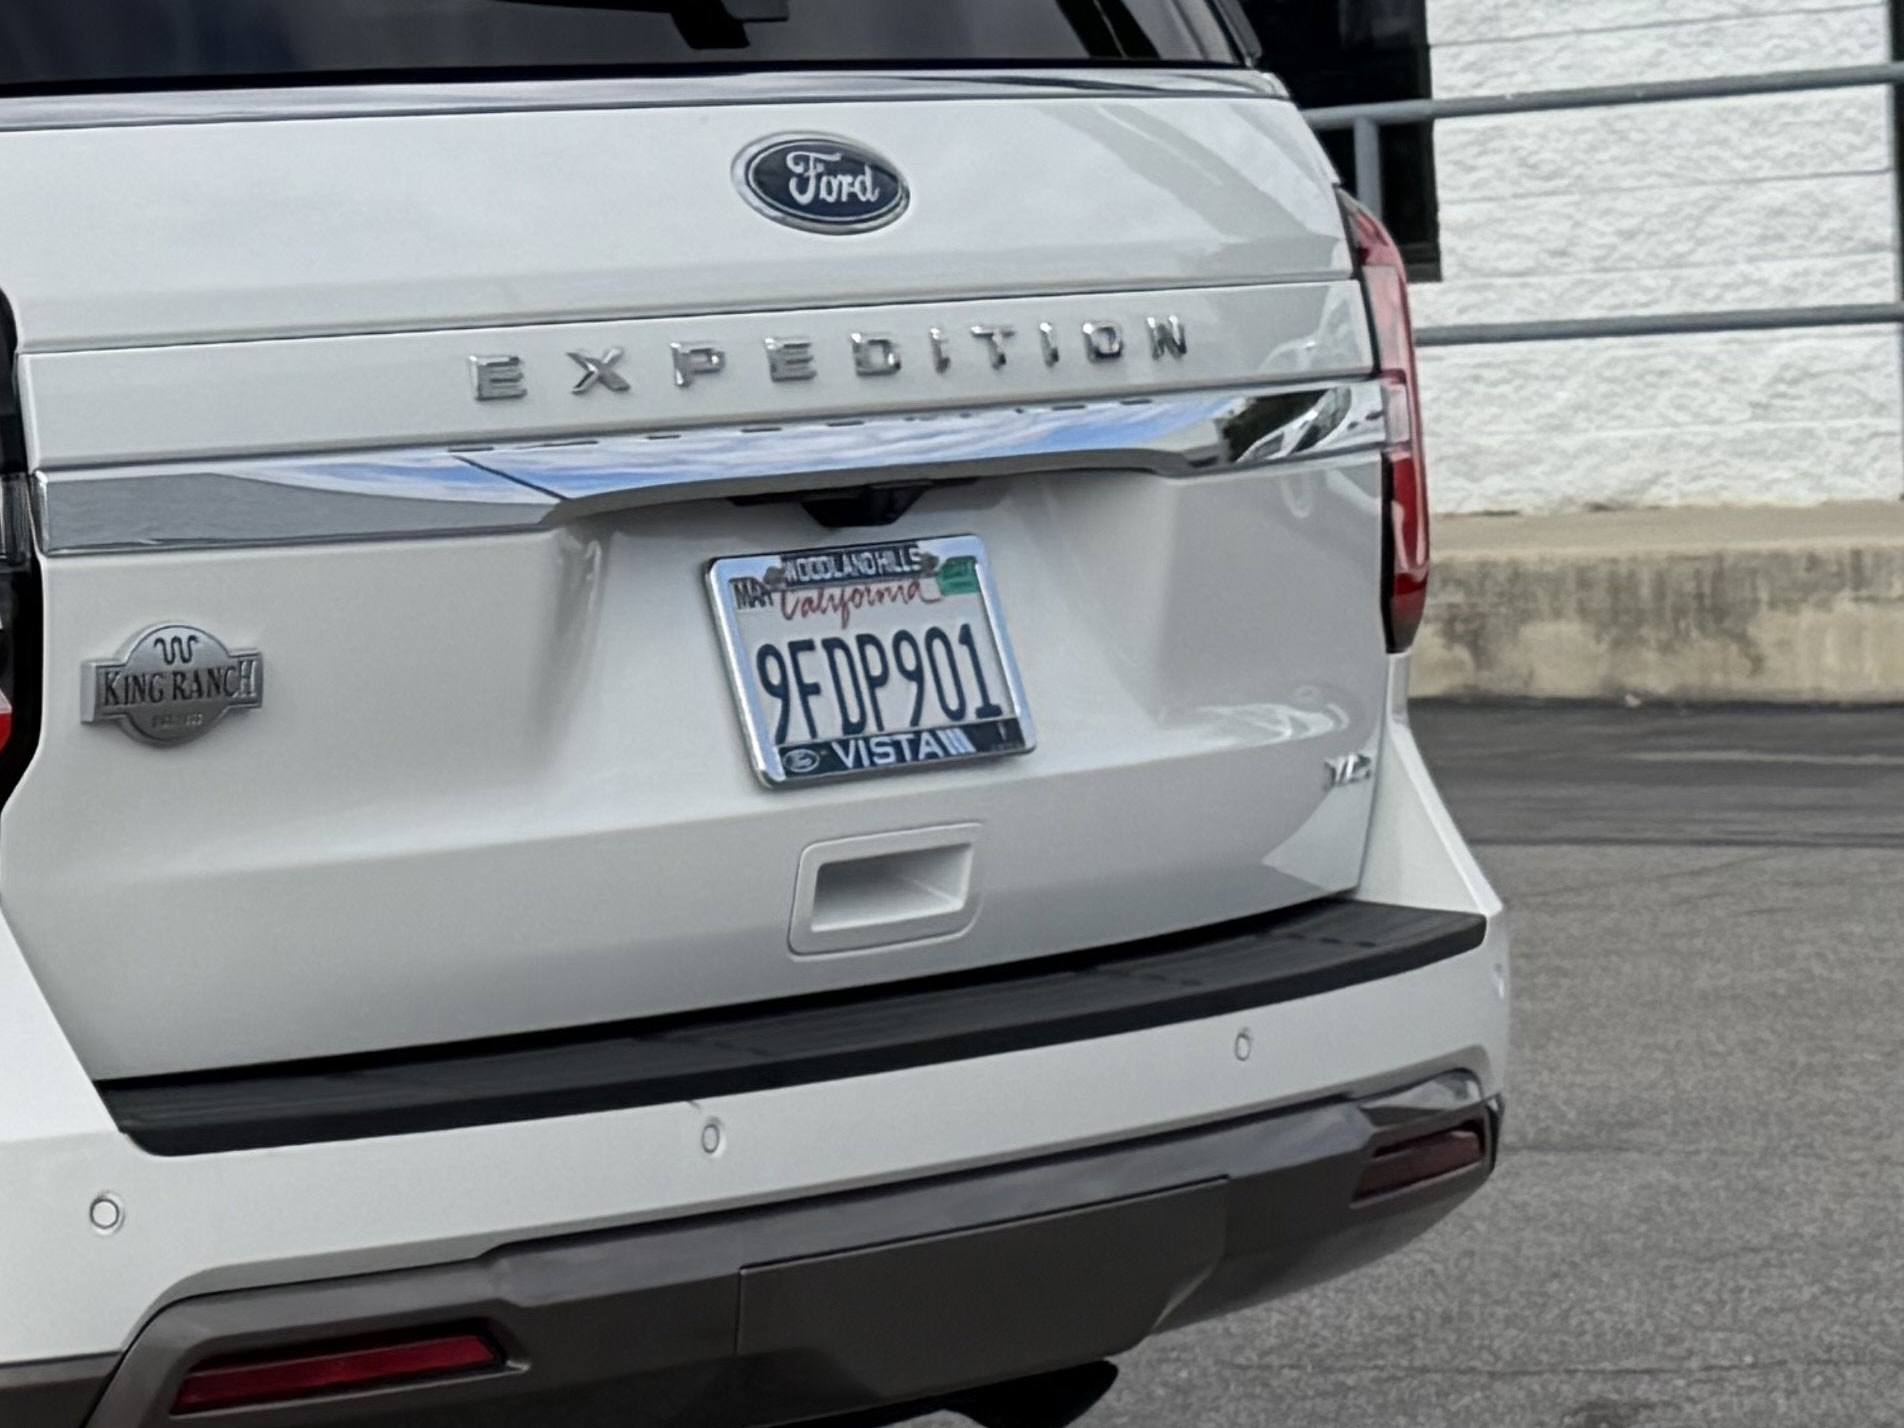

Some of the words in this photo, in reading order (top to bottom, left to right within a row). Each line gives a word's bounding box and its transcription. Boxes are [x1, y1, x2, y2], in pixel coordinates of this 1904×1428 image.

[785, 150, 880, 206] Ford
[467, 314, 1189, 403] EXPEDITION
[783, 550, 876, 583] WOODLAND
[876, 547, 923, 576] HILLS
[780, 579, 942, 629] California
[103, 671, 164, 707] KING
[171, 659, 258, 701] RANCH
[755, 623, 1003, 745] 9FDP901
[832, 733, 946, 769] VISTA
